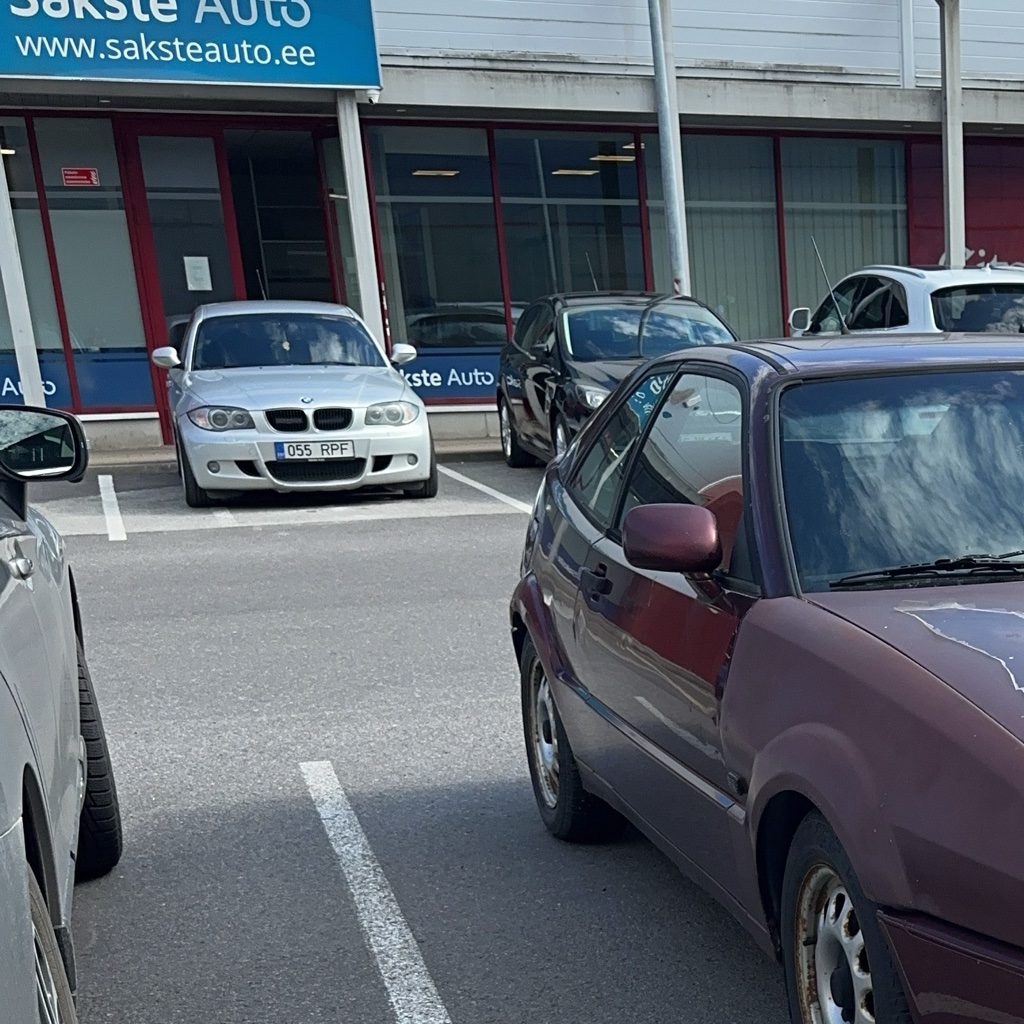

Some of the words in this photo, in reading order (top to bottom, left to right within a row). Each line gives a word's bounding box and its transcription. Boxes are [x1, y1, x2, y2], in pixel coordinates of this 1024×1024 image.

[194, 0, 312, 28] Auto
[15, 33, 316, 66] www.saksteauto.ee
[447, 368, 494, 386] Auto
[287, 444, 313, 457] 055
[320, 442, 349, 456] RPF
